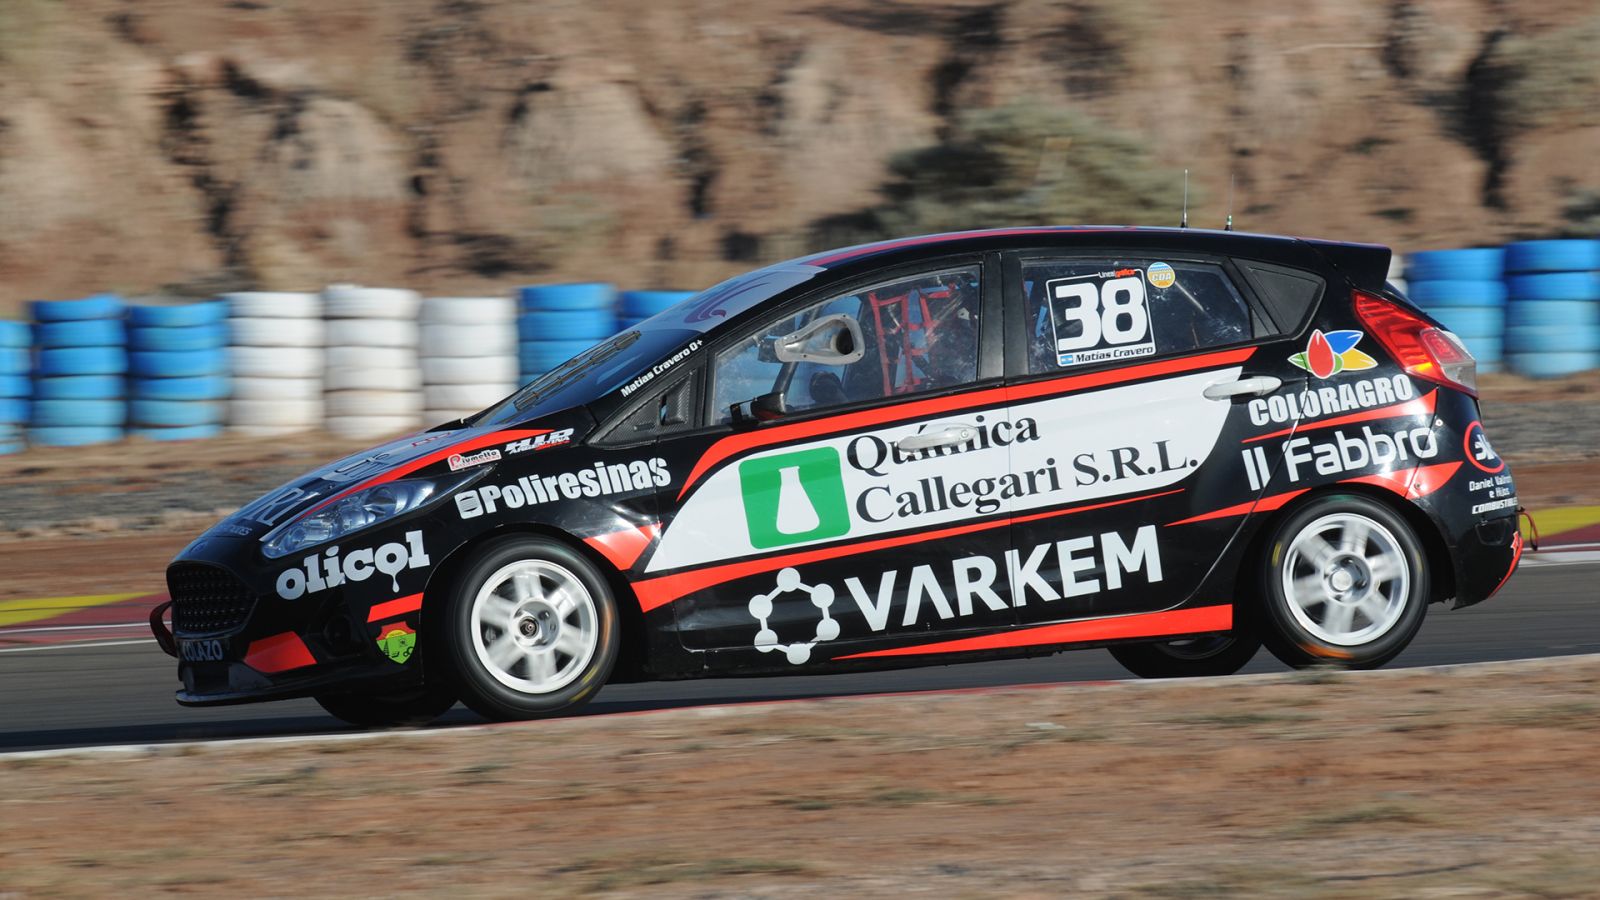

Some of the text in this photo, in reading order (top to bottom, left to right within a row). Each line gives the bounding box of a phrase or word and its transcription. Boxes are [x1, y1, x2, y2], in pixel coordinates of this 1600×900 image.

[1055, 276, 1148, 351] 38
[653, 348, 691, 374] Cravero
[1113, 346, 1153, 359] Cravero
[1249, 374, 1414, 426] COLORAGRO
[856, 440, 1199, 523] Callegari S.R.L.
[1281, 425, 1438, 482] Fabbro
[479, 457, 671, 513] Poliresinas
[276, 530, 430, 600] olicol
[844, 525, 1163, 632] VARKEM
